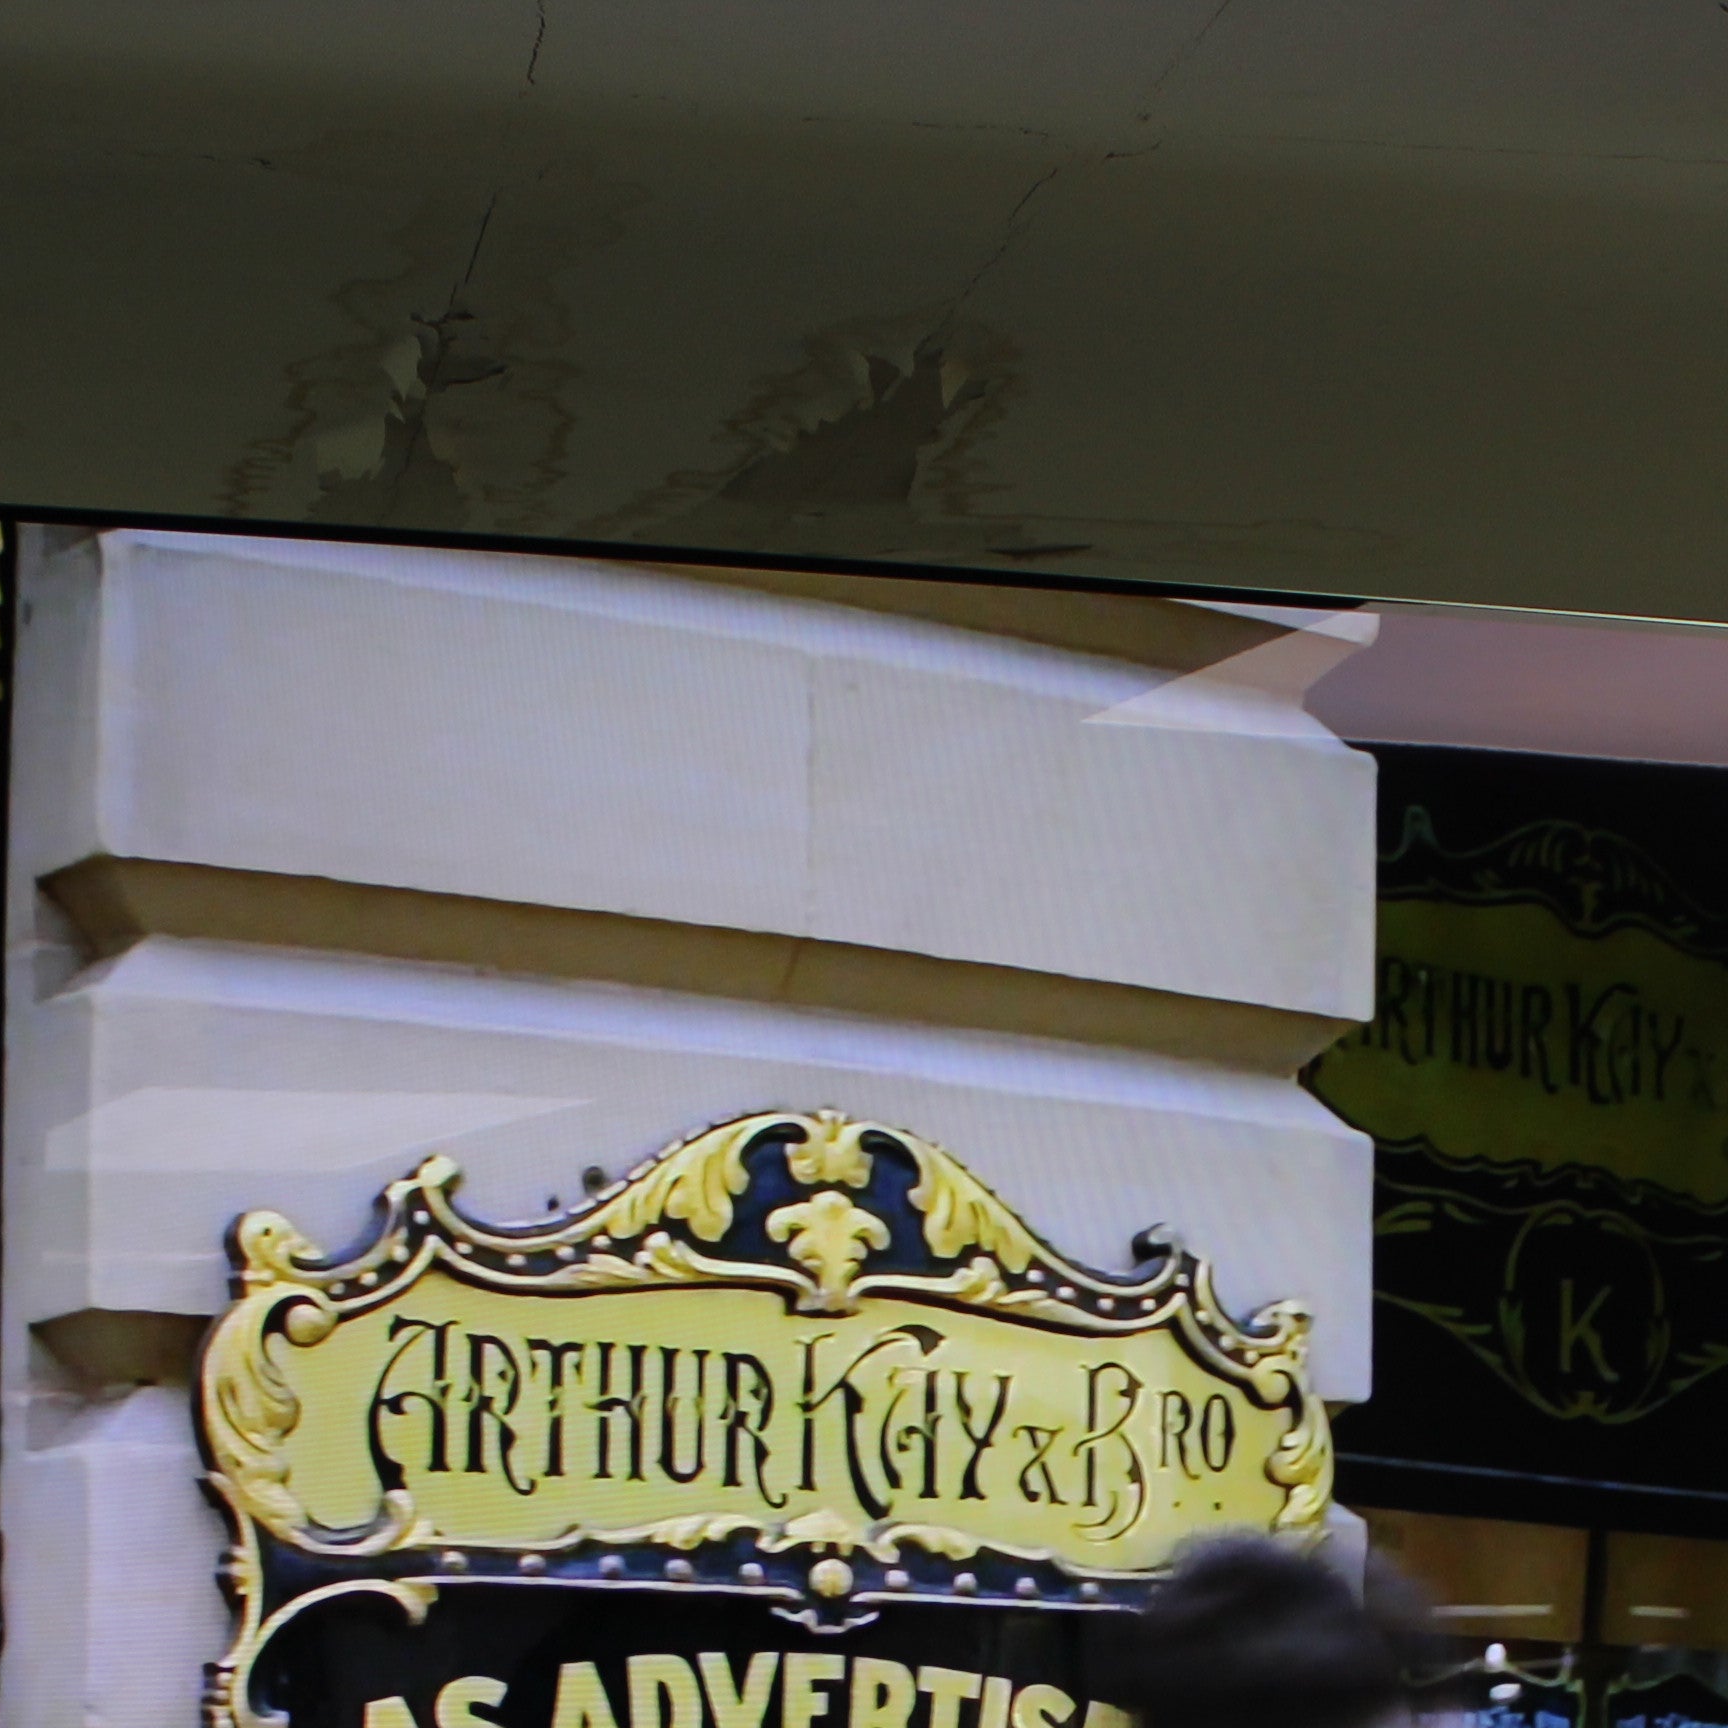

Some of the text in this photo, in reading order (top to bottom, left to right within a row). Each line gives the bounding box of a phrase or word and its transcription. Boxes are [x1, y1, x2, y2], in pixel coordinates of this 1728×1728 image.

[1560, 1278, 1620, 1381] K
[367, 1315, 789, 1508] ARTHUR
[792, 1325, 1016, 1519] KAY
